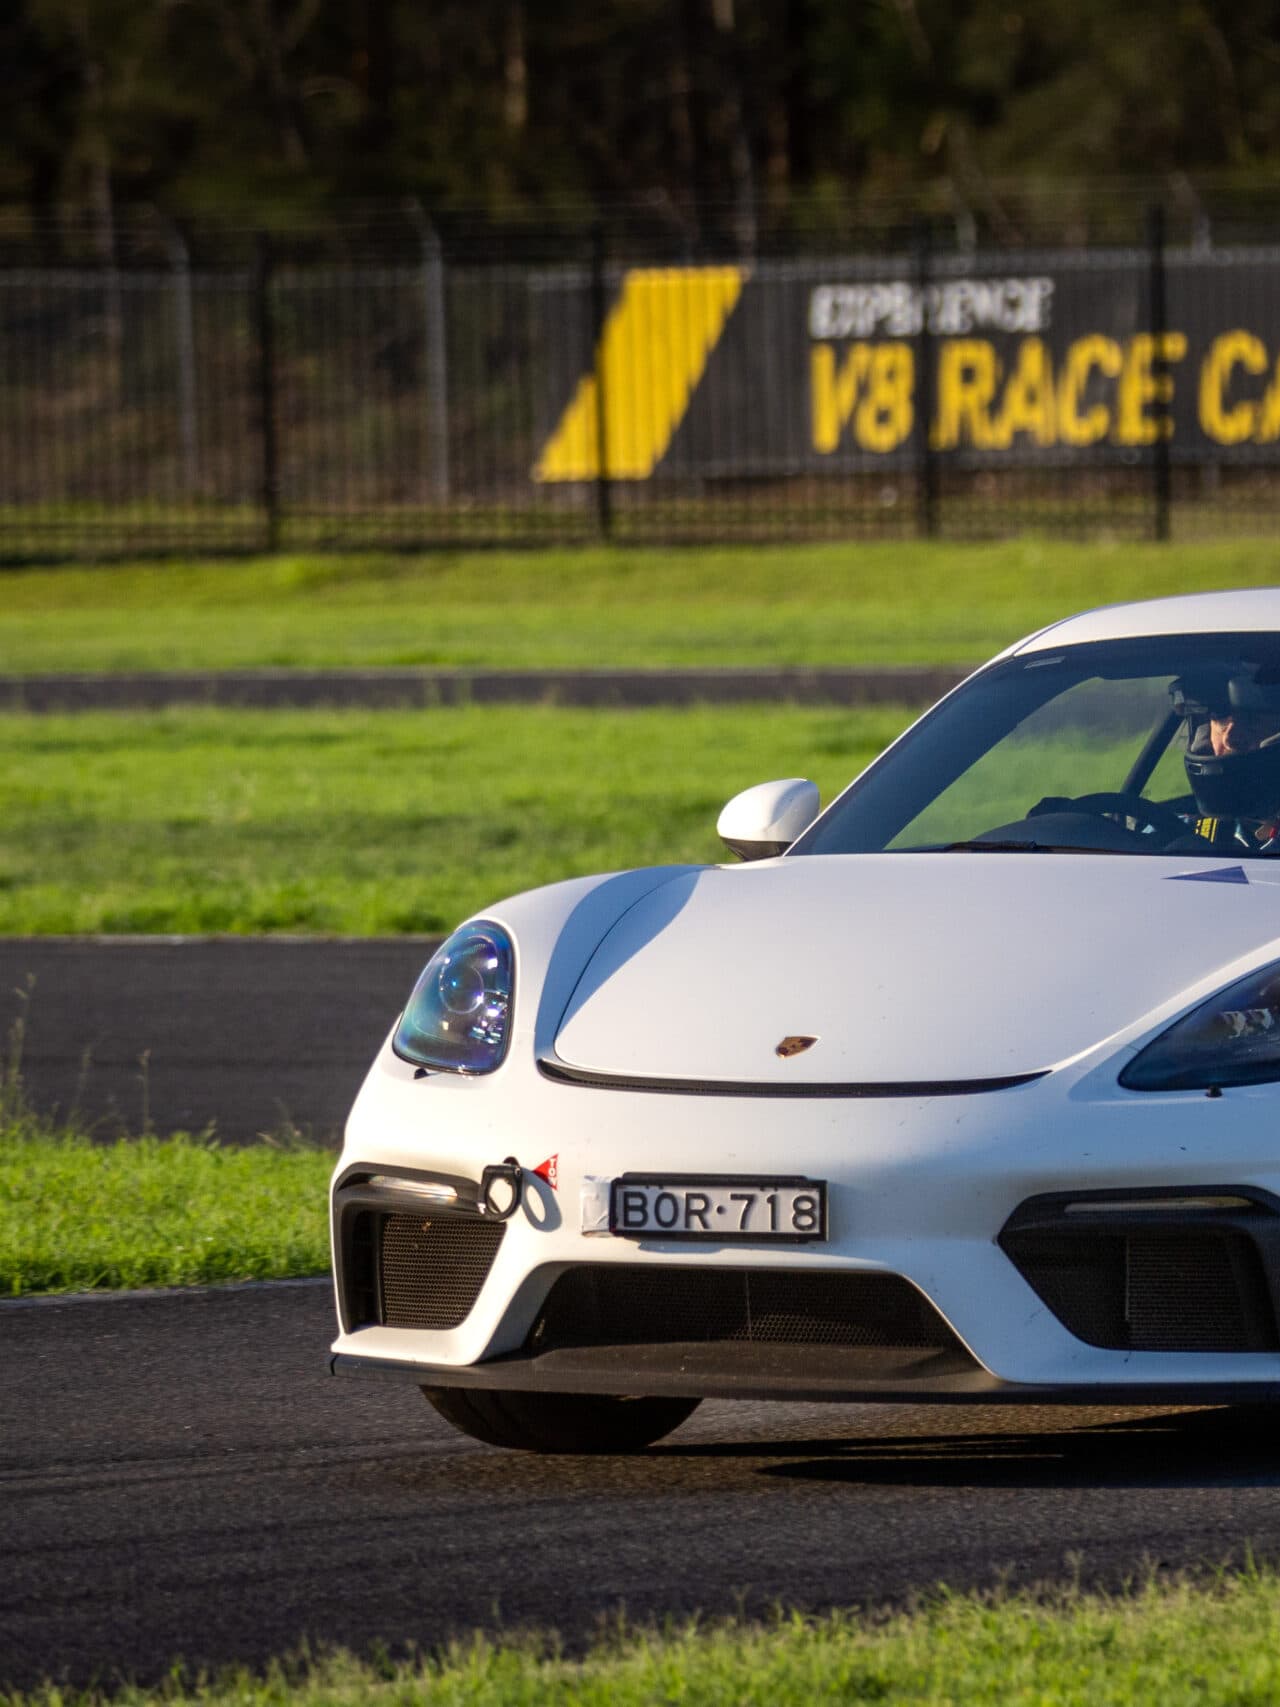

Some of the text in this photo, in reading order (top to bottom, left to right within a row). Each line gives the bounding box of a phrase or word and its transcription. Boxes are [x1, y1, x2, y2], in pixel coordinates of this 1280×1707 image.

[808, 275, 1055, 338] EXPEIENCE
[810, 341, 915, 454] V8
[928, 331, 1188, 449] RACE
